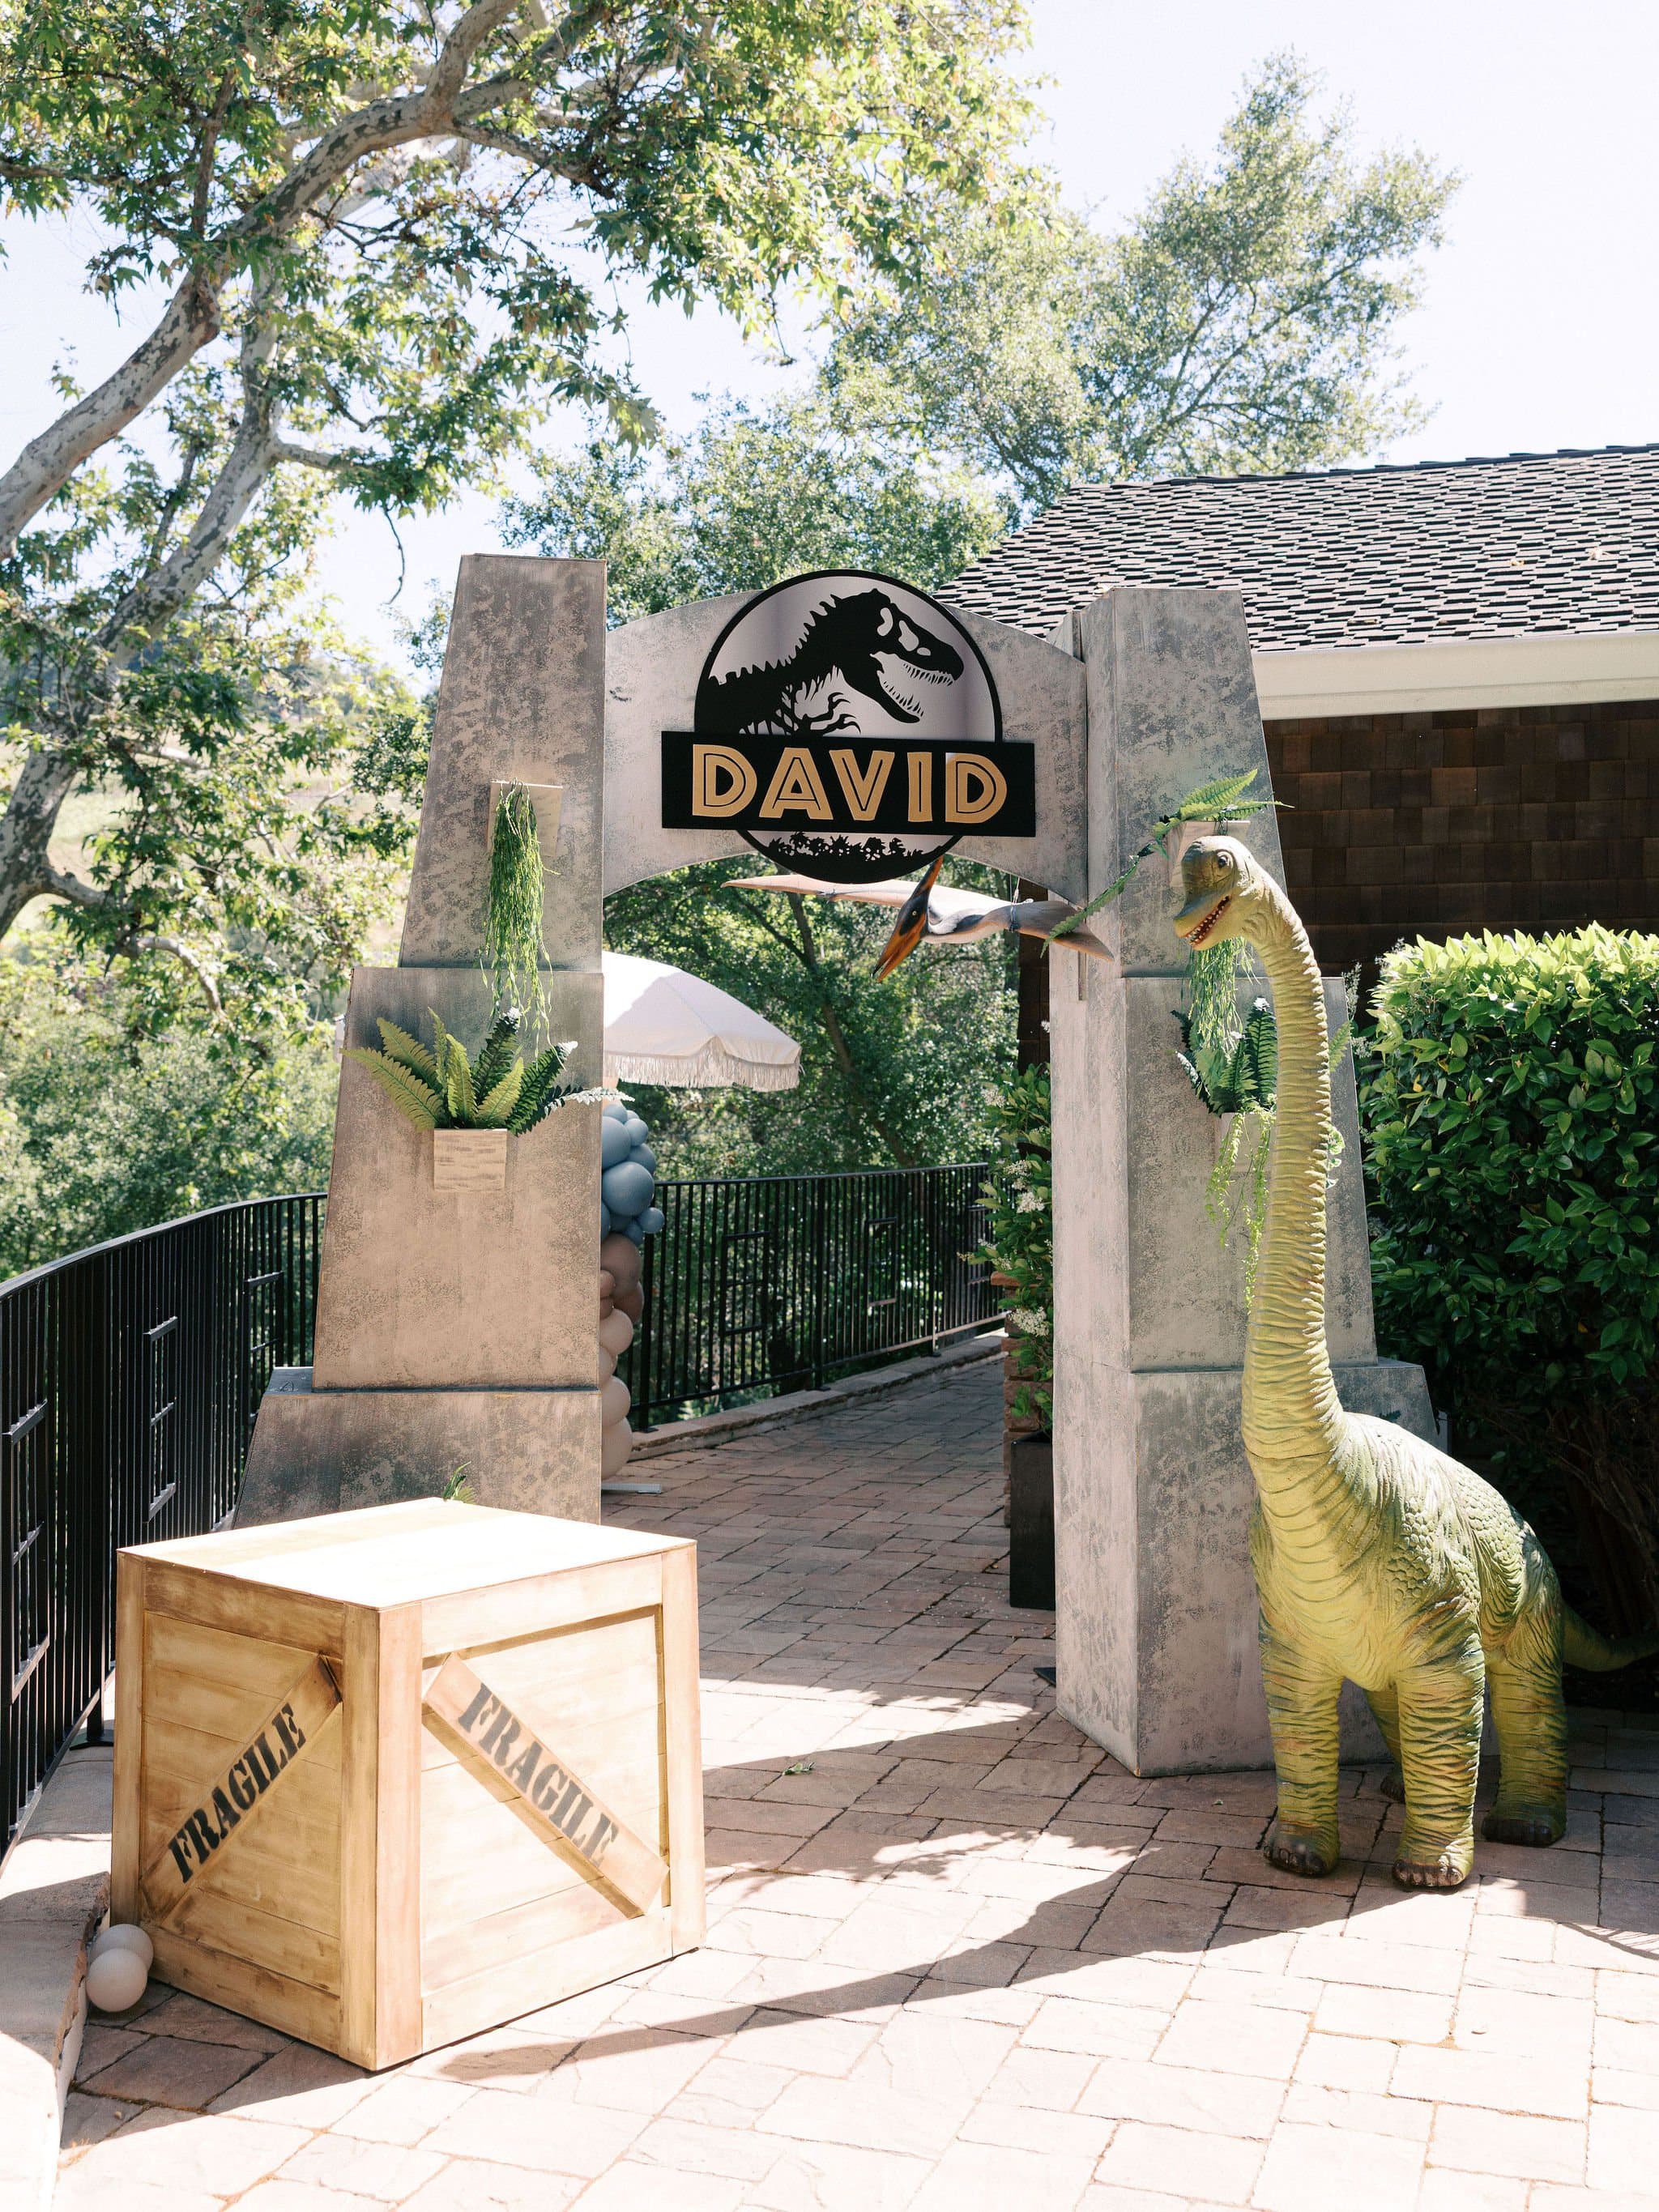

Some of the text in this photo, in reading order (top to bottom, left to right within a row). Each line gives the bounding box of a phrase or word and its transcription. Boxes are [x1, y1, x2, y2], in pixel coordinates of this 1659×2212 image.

[693, 744, 1007, 823] DAVID
[168, 1703, 306, 1882] FRAGILE
[458, 1682, 618, 1866] FRAGILE
